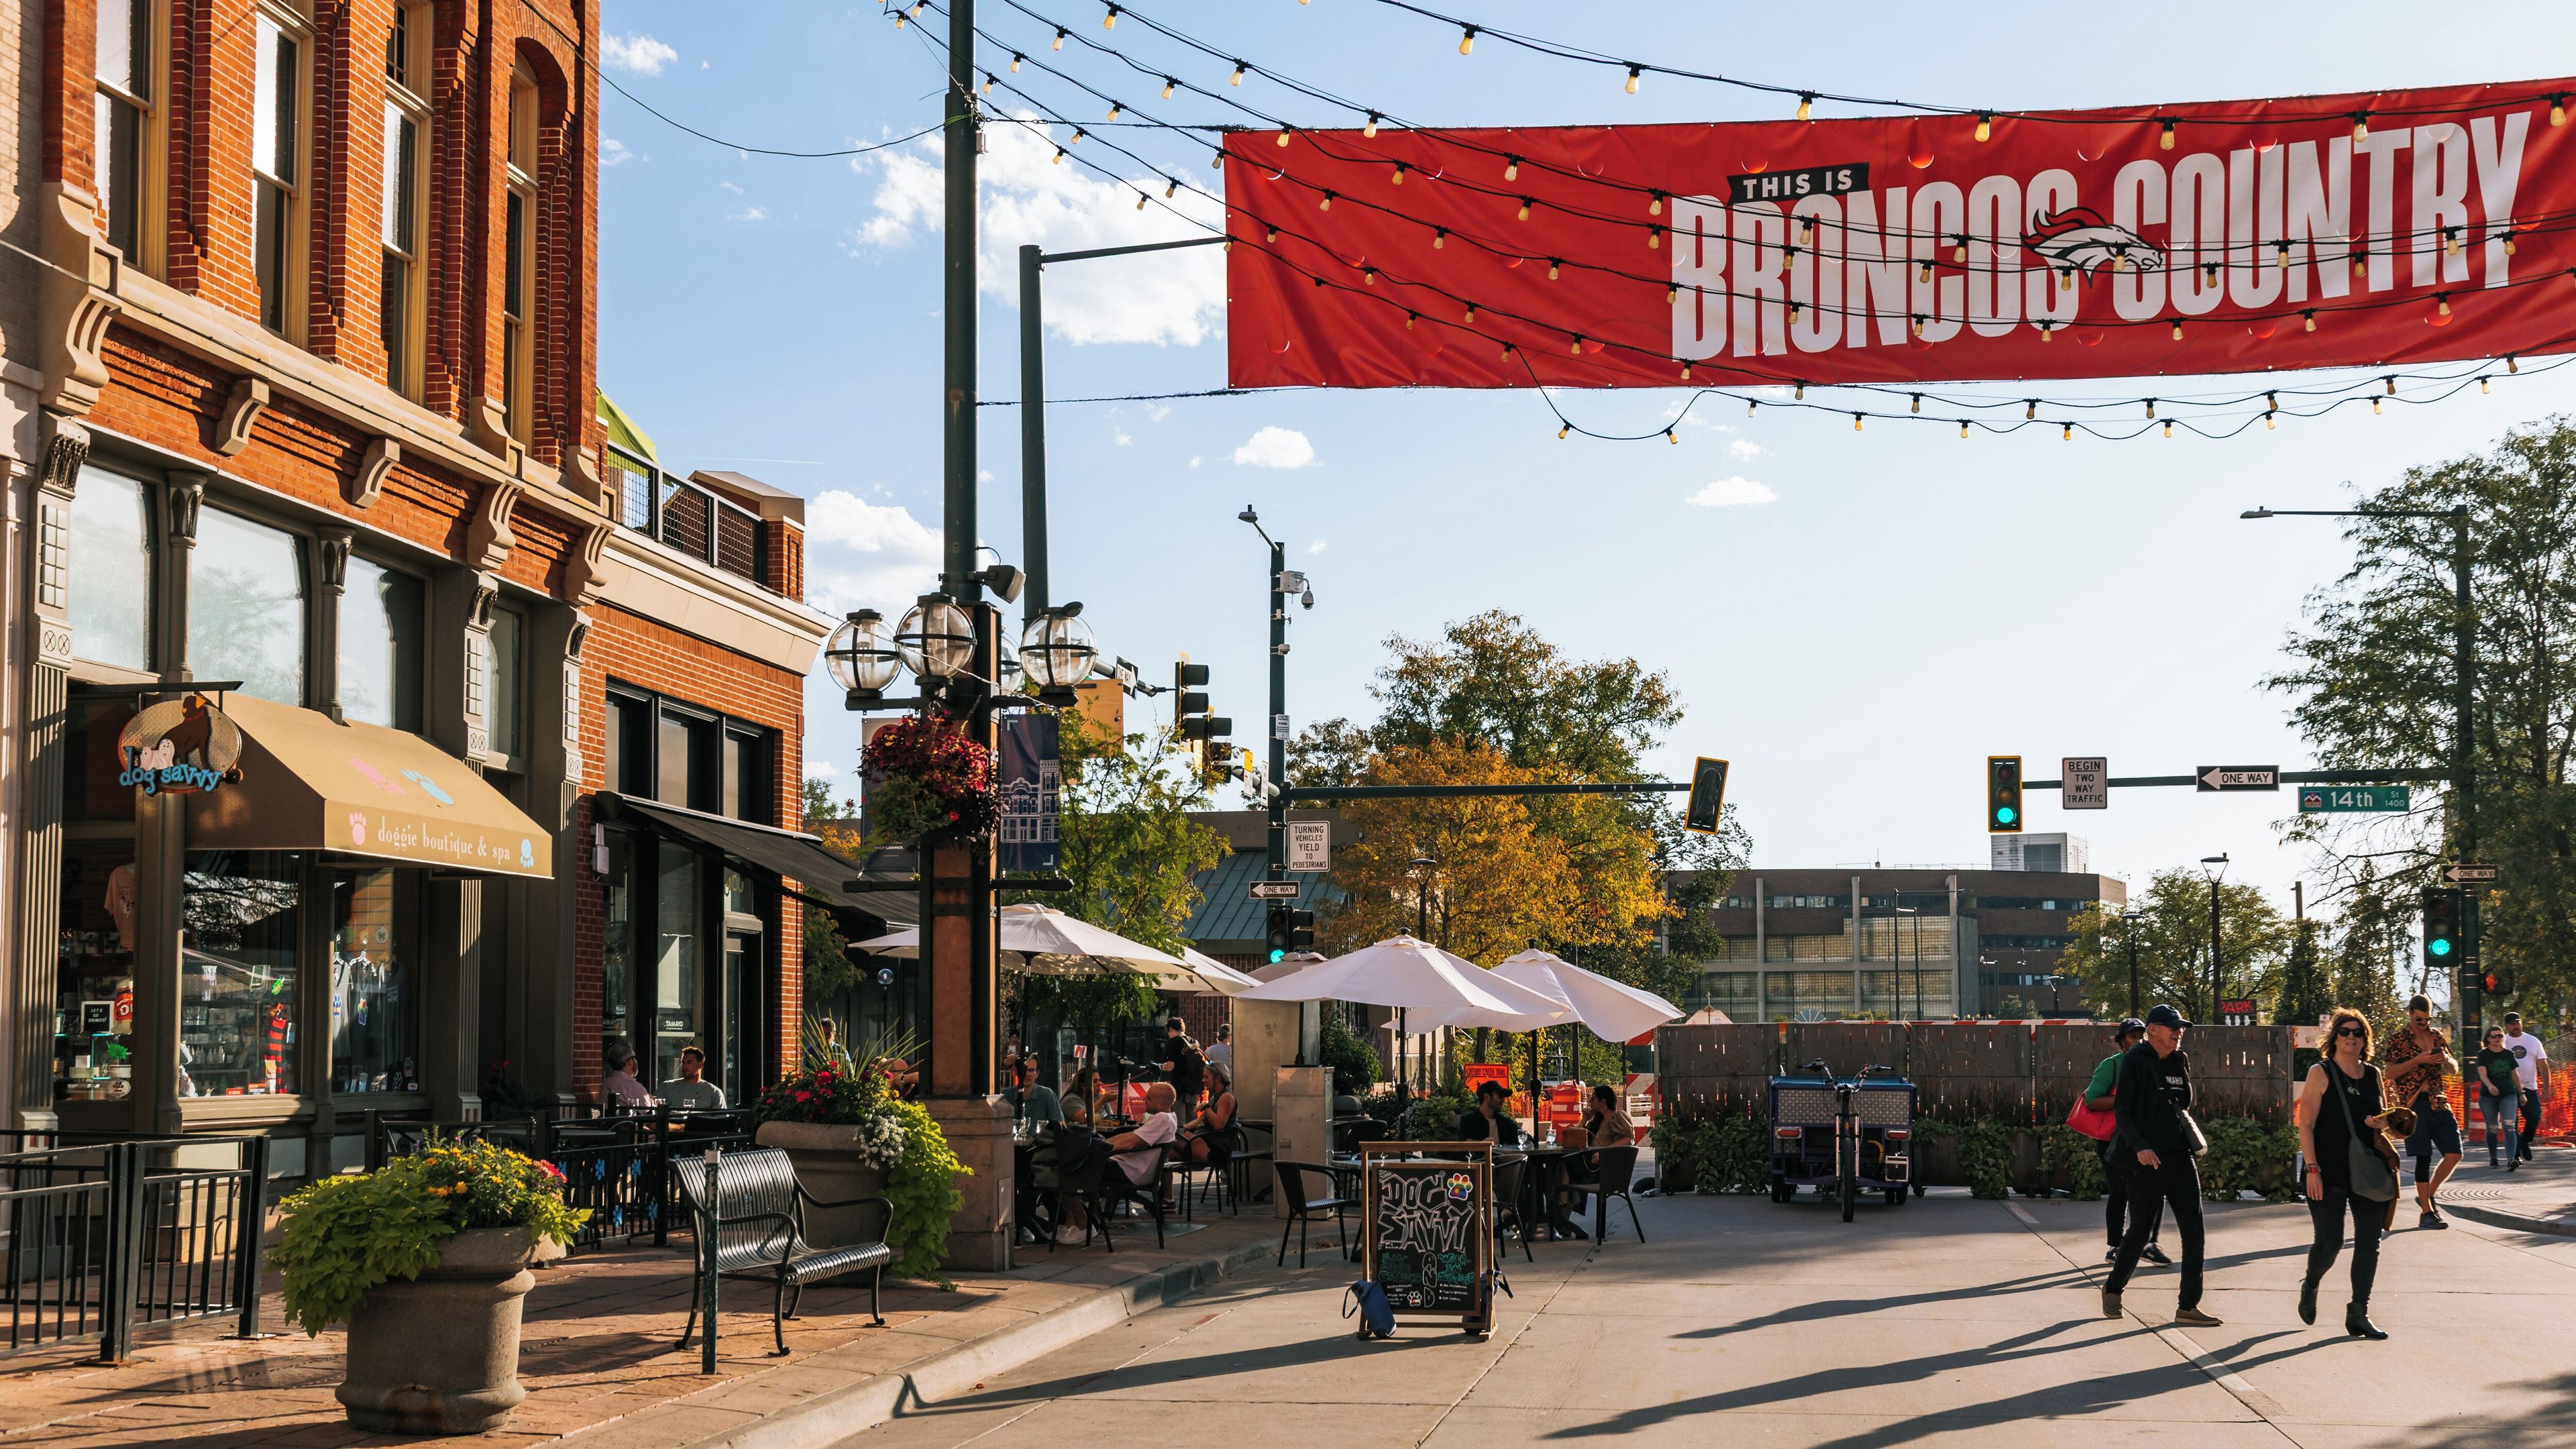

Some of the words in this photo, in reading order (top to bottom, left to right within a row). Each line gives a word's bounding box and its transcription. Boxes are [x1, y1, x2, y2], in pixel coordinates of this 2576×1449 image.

[1743, 173, 1811, 200] THIS
[1825, 169, 1853, 192] IS
[1669, 166, 2080, 362] BRONCOS
[2112, 110, 2534, 318] COUNTRY
[119, 745, 156, 796] dog
[160, 763, 223, 792] savvy
[2068, 761, 2101, 771] BEGIN
[2075, 773, 2094, 782] TWO
[2221, 773, 2243, 784] ONE
[2247, 772, 2270, 784] WAY
[2075, 784, 2094, 793] WAY
[2067, 794, 2103, 803] TRAFFIC
[2330, 791, 2373, 808] 14th
[1294, 826, 1324, 834] TURNING
[378, 815, 418, 853] doggie
[423, 822, 473, 859] boutique
[478, 836, 488, 857] &
[492, 846, 511, 865] spa
[1299, 843, 1320, 851] YIELD
[1292, 861, 1327, 869] PEDESTRIANS
[1382, 1173, 1448, 1213] DOG
[1377, 1205, 1475, 1252] SAVVY
[1422, 1252, 1438, 1308] AND
